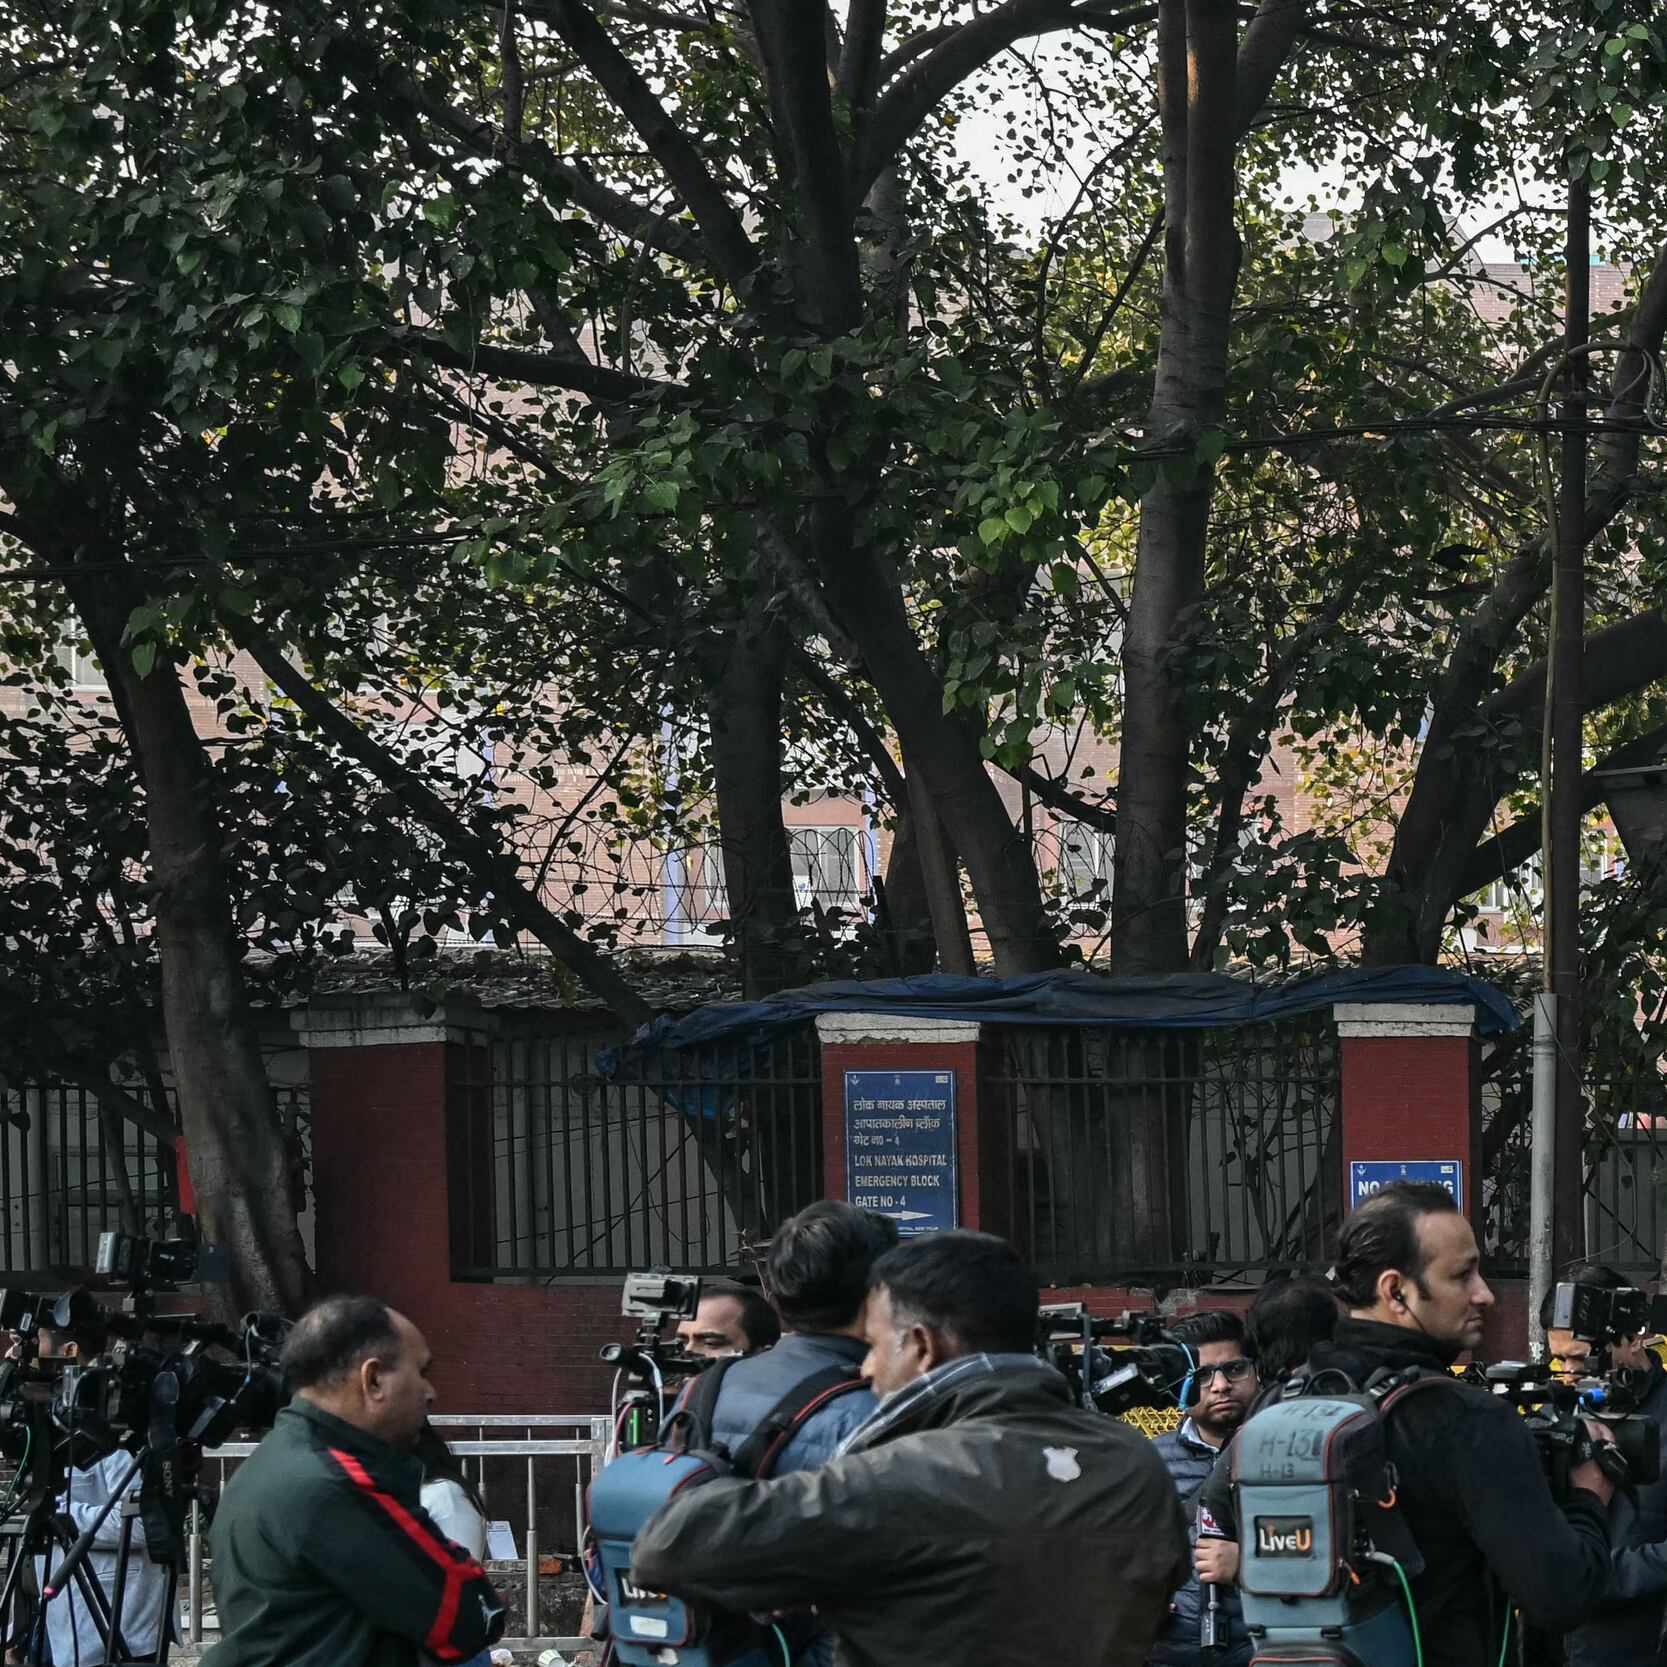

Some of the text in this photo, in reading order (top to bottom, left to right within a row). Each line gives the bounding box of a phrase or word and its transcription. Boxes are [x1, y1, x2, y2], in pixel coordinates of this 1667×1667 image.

[853, 1097, 947, 1110] लोक नायक अस्पताल
[854, 1154, 947, 1167] LOK NAYAK HOSPITAL
[855, 1175, 940, 1187] EMERGENCY BLOCK
[1358, 1180, 1381, 1196] NO
[855, 1195, 878, 1208] GATE
[880, 1195, 893, 1207] NO
[899, 1195, 906, 1207] 4
[1259, 1526, 1312, 1551] LiveU
